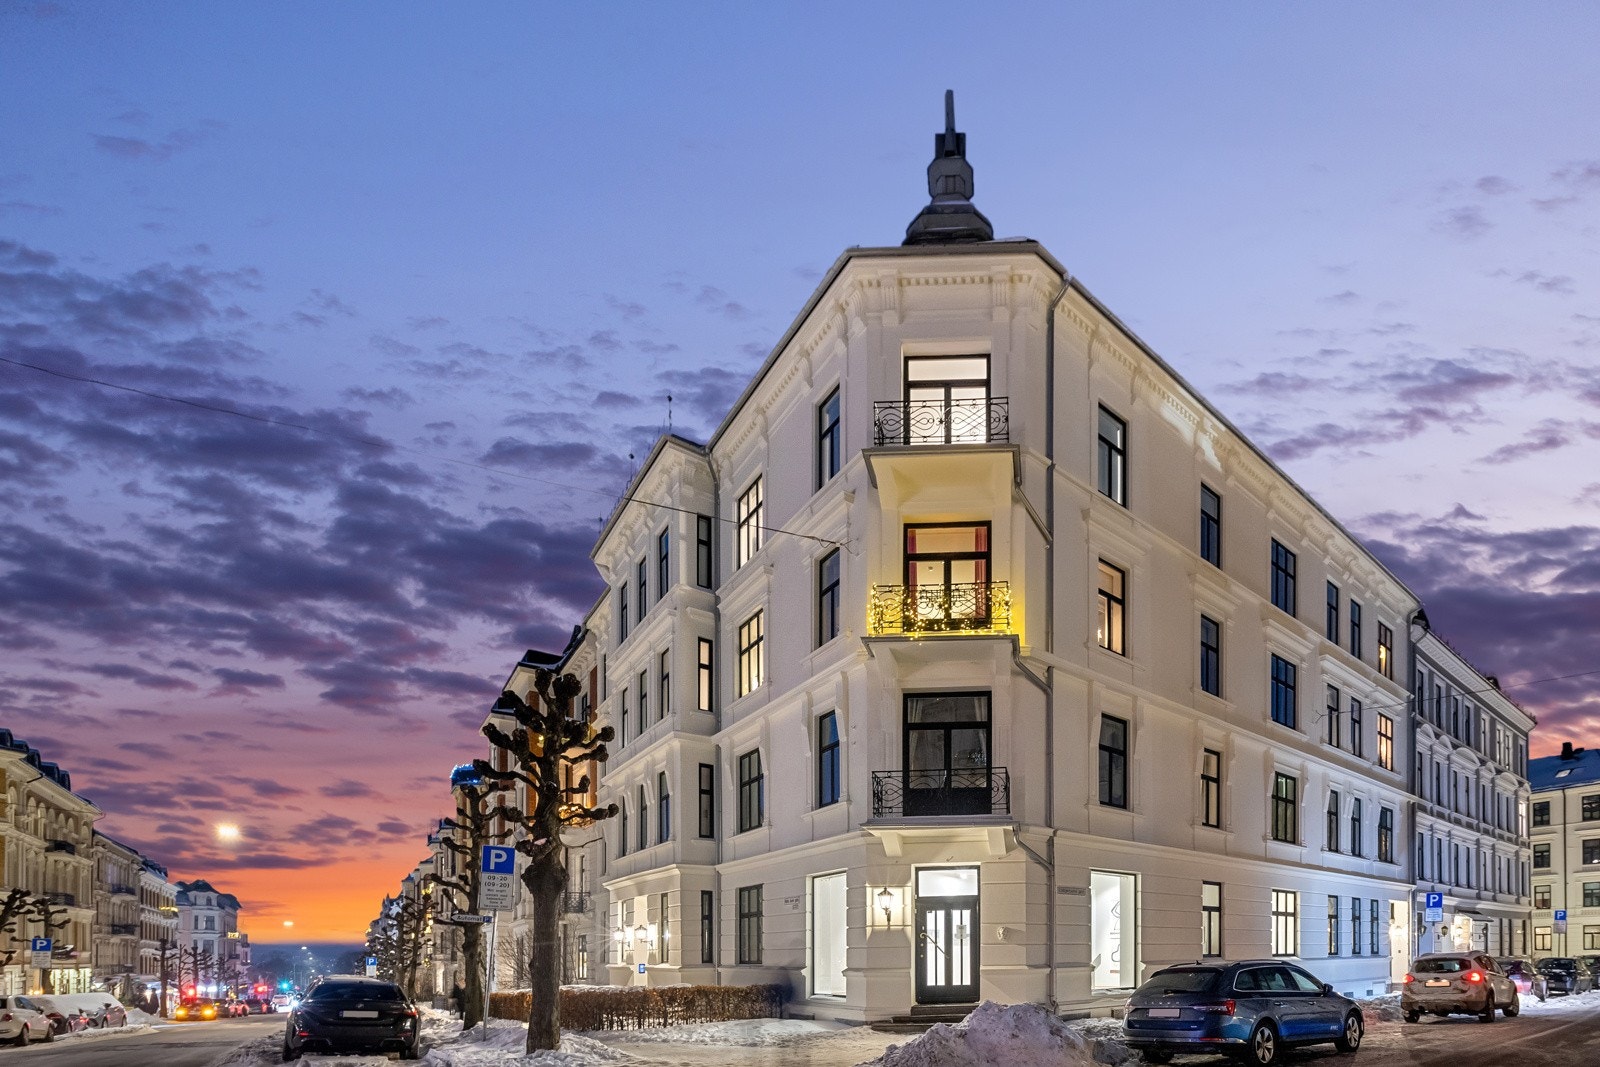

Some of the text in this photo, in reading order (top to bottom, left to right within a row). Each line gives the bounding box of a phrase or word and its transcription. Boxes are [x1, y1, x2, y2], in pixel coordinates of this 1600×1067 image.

[489, 849, 508, 870] P
[1430, 895, 1439, 906] P
[36, 940, 48, 950] P
